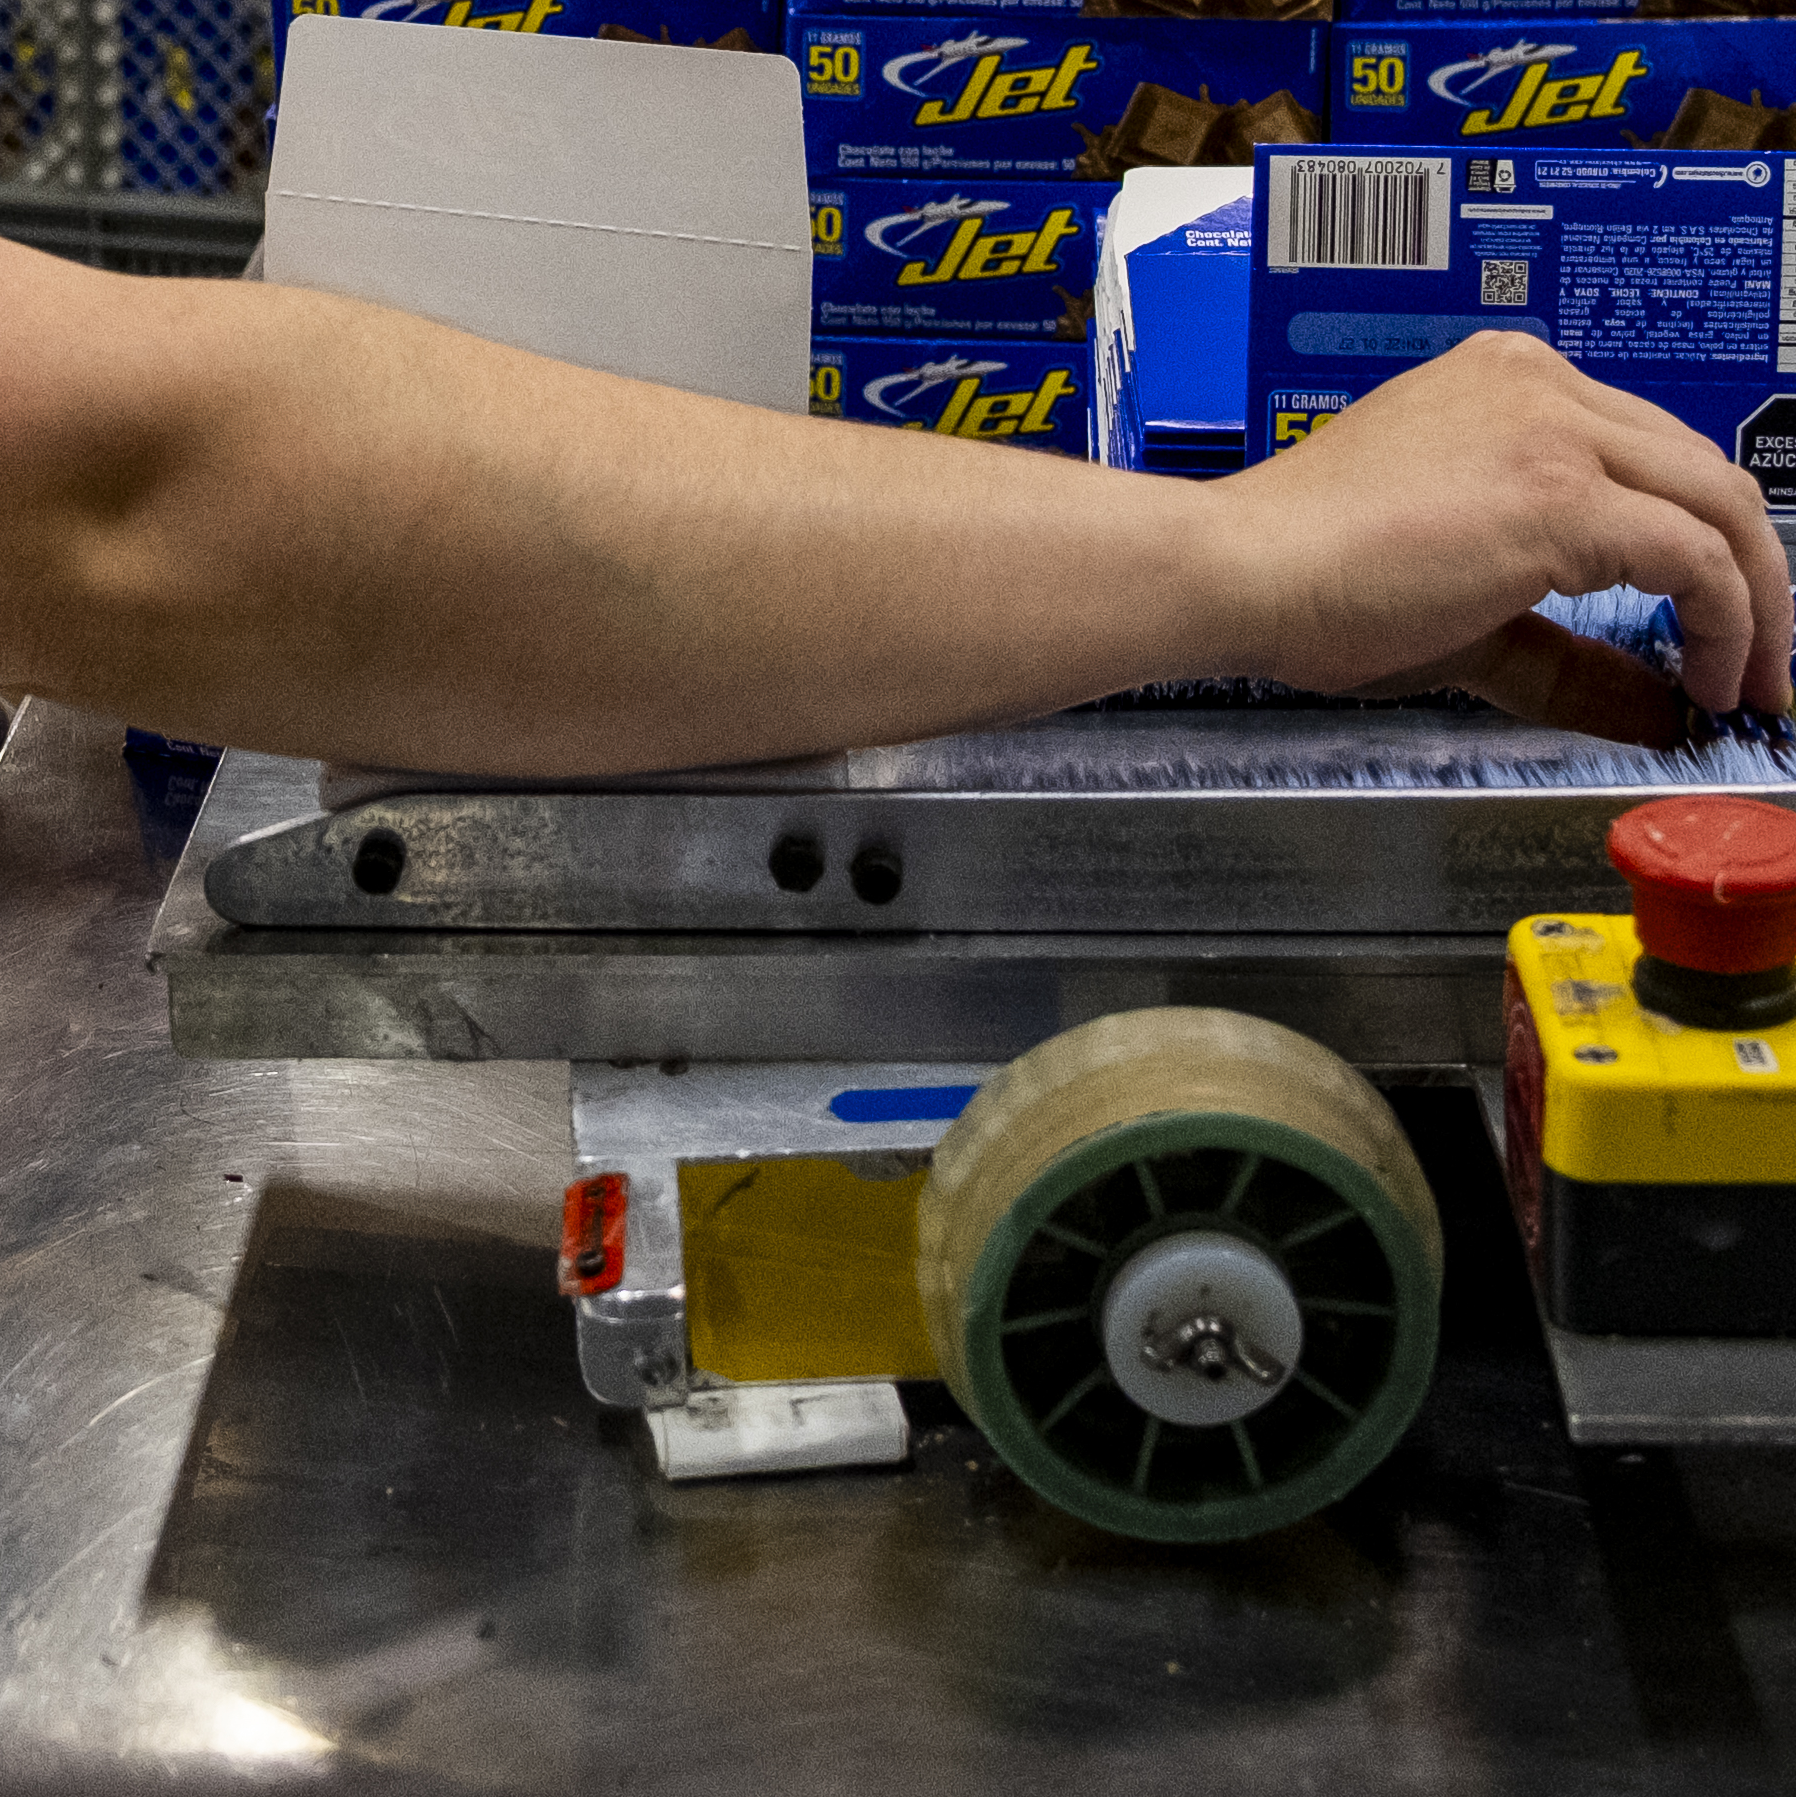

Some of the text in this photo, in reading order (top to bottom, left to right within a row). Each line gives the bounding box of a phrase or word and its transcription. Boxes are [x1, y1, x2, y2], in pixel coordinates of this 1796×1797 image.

[808, 46, 859, 82] 50
[1352, 57, 1404, 94] 50
[914, 46, 1098, 125] Jet
[1460, 51, 1648, 136] Jet
[1294, 159, 1447, 175] 7 702007 080483
[810, 207, 843, 242] 0
[1185, 230, 1252, 238] Chocolat
[896, 210, 1079, 285] Jet
[1670, 237, 1711, 246] Colombia
[1728, 238, 1773, 247] Fabricado
[1559, 288, 1566, 296] Y
[1574, 288, 1599, 297] SOYA
[809, 367, 842, 402] 0
[1274, 394, 1348, 410] 11 GRAMOS
